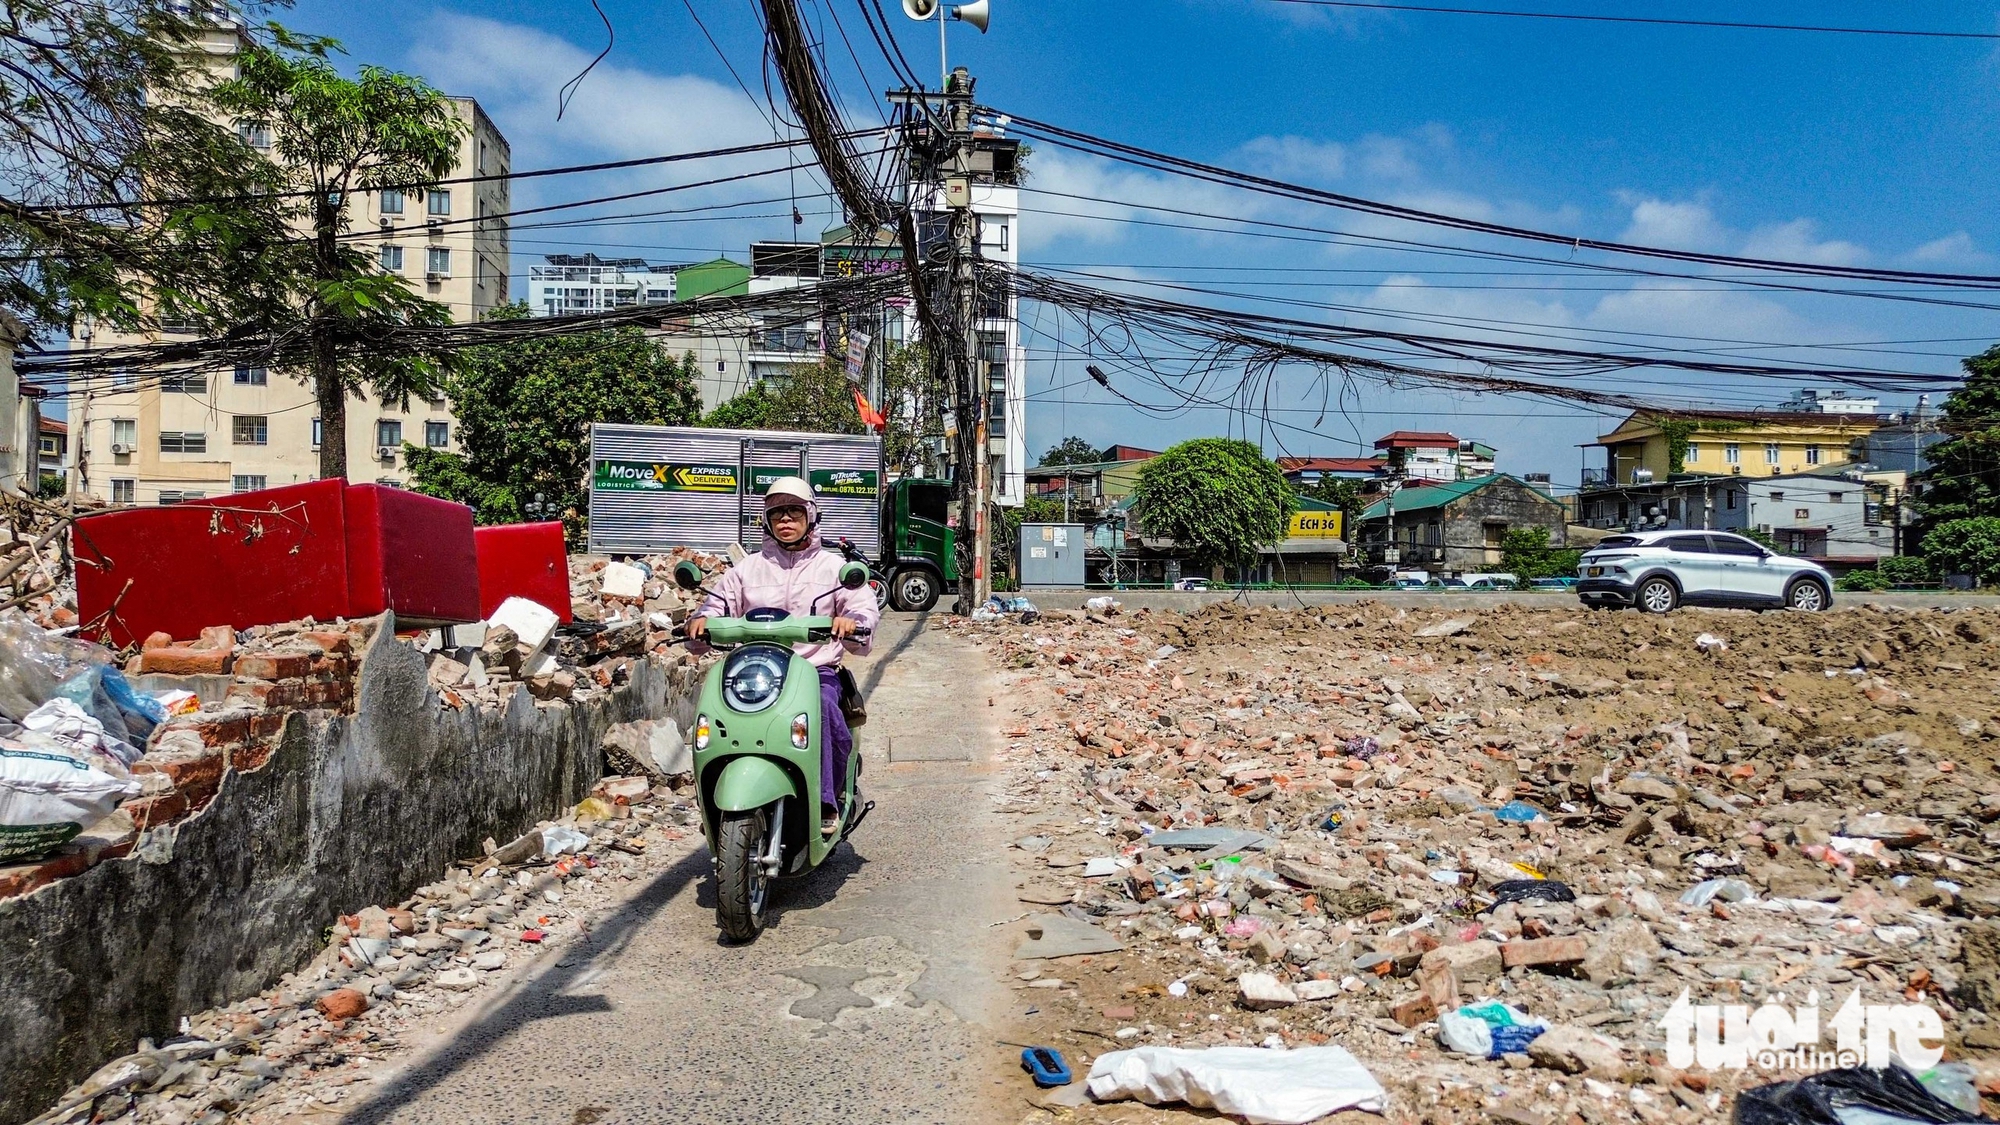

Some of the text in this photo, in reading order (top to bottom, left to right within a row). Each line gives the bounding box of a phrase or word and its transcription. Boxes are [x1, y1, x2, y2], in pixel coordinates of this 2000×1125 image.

[609, 464, 670, 482] MoveX
[691, 467, 732, 475] EXPRESS
[693, 476, 732, 484] DELIVERY
[1300, 515, 1319, 530] ẾCH
[1321, 519, 1334, 530] 36
